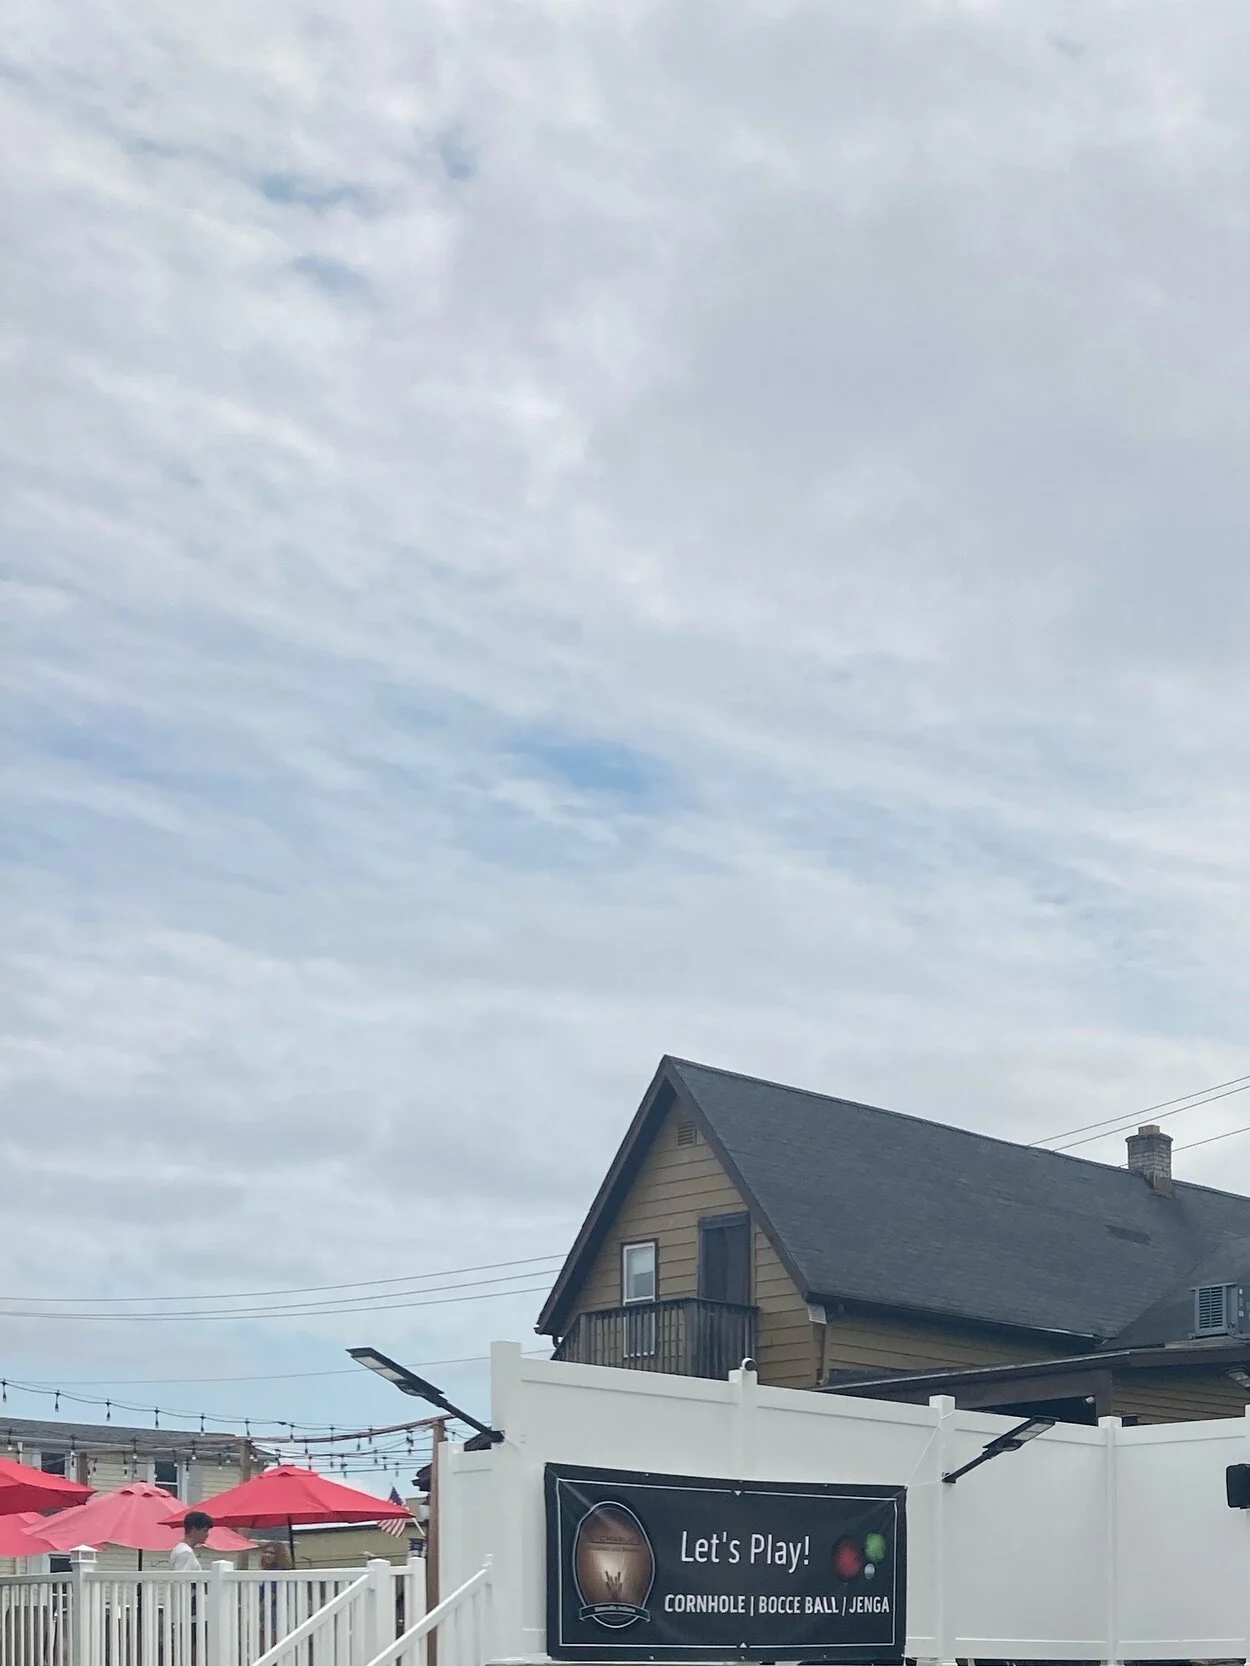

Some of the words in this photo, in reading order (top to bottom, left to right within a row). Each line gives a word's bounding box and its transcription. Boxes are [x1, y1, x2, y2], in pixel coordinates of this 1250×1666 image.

[681, 1531, 740, 1563] Let's
[750, 1534, 810, 1573] Play!
[664, 1594, 746, 1613] CORNHOLE
[759, 1595, 801, 1614] BOCCE
[805, 1595, 839, 1614] BALL
[849, 1596, 890, 1613] JENGA
